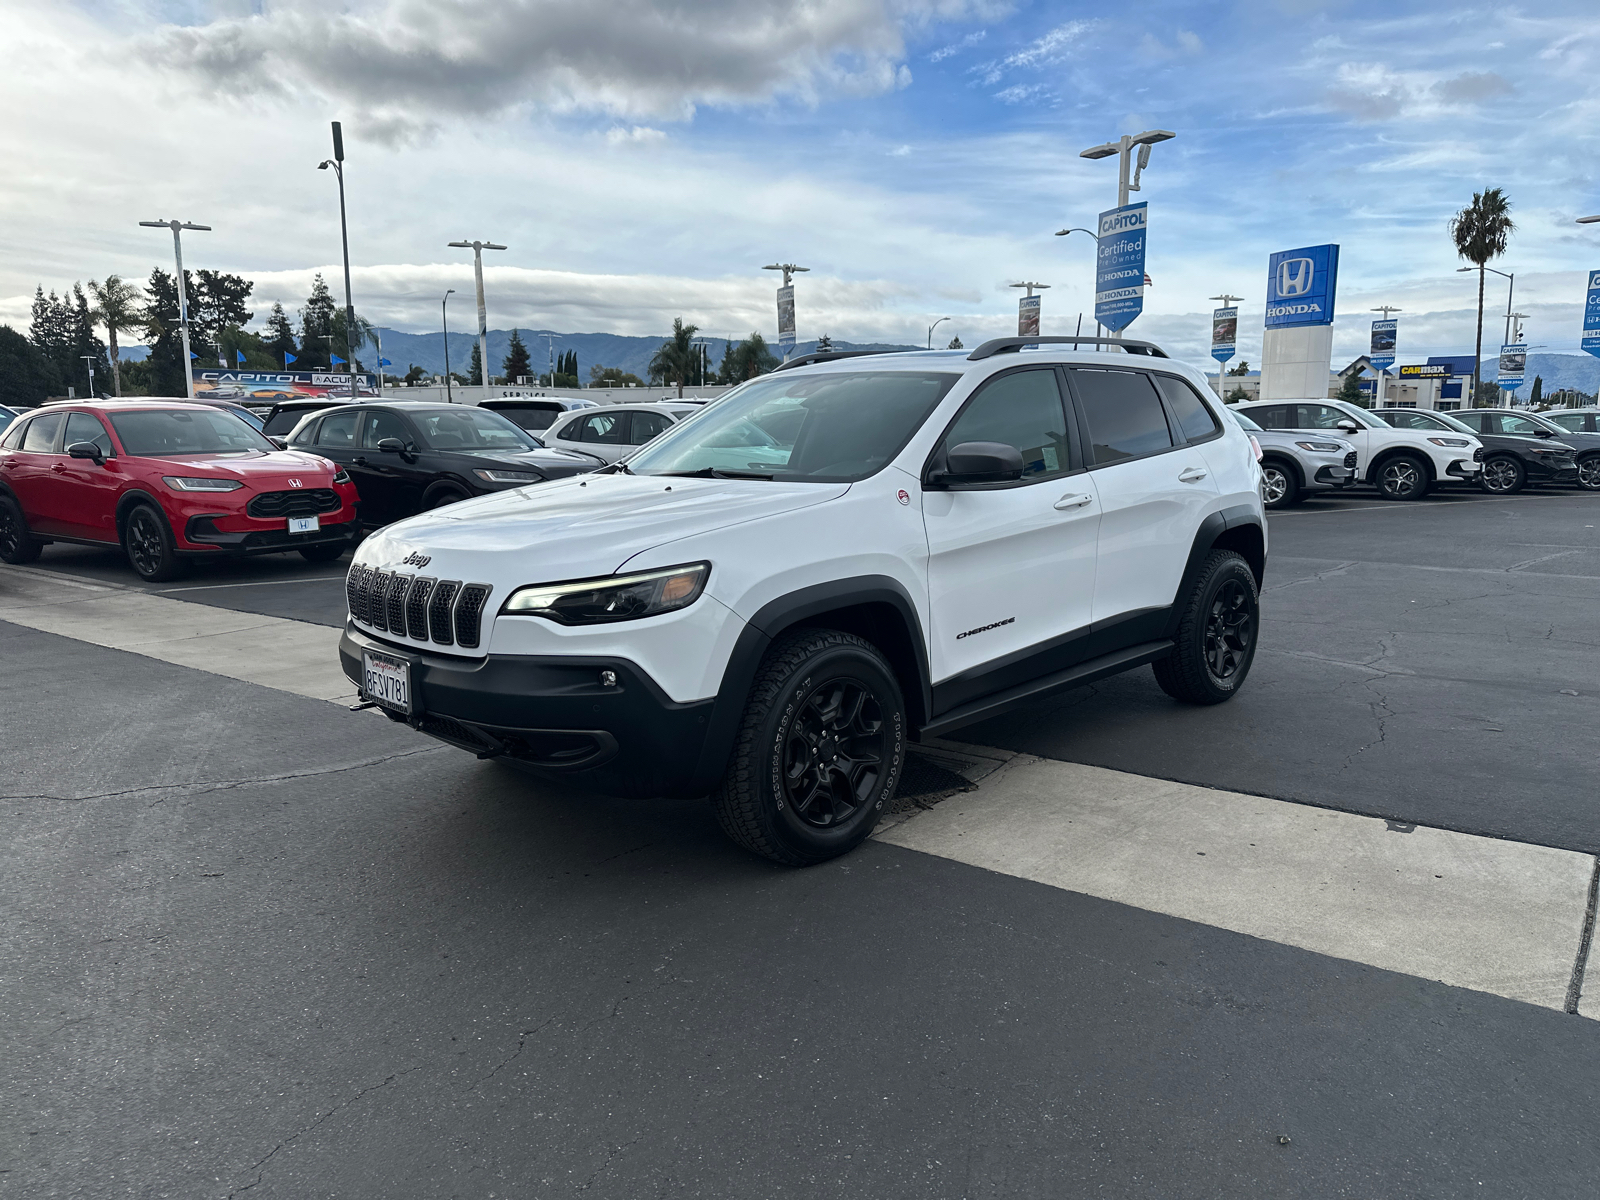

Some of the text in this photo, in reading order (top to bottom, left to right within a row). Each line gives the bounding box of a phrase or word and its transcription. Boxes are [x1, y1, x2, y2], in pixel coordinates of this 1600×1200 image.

[1102, 213, 1145, 232] CAPITOL
[1099, 236, 1142, 258] Certified
[1098, 252, 1141, 267] Pre-Owned
[1104, 269, 1140, 281] HONDA
[1104, 289, 1138, 300] HONDA
[1267, 303, 1322, 317] HONDA
[201, 372, 311, 383] CAPITOL
[402, 551, 431, 569] Jeep
[956, 616, 1016, 640] CHEROKEE
[366, 669, 408, 704] 8FSV781
[363, 692, 408, 714] CAPITOL HONDA
[772, 677, 812, 811] DESTINATION A/T
